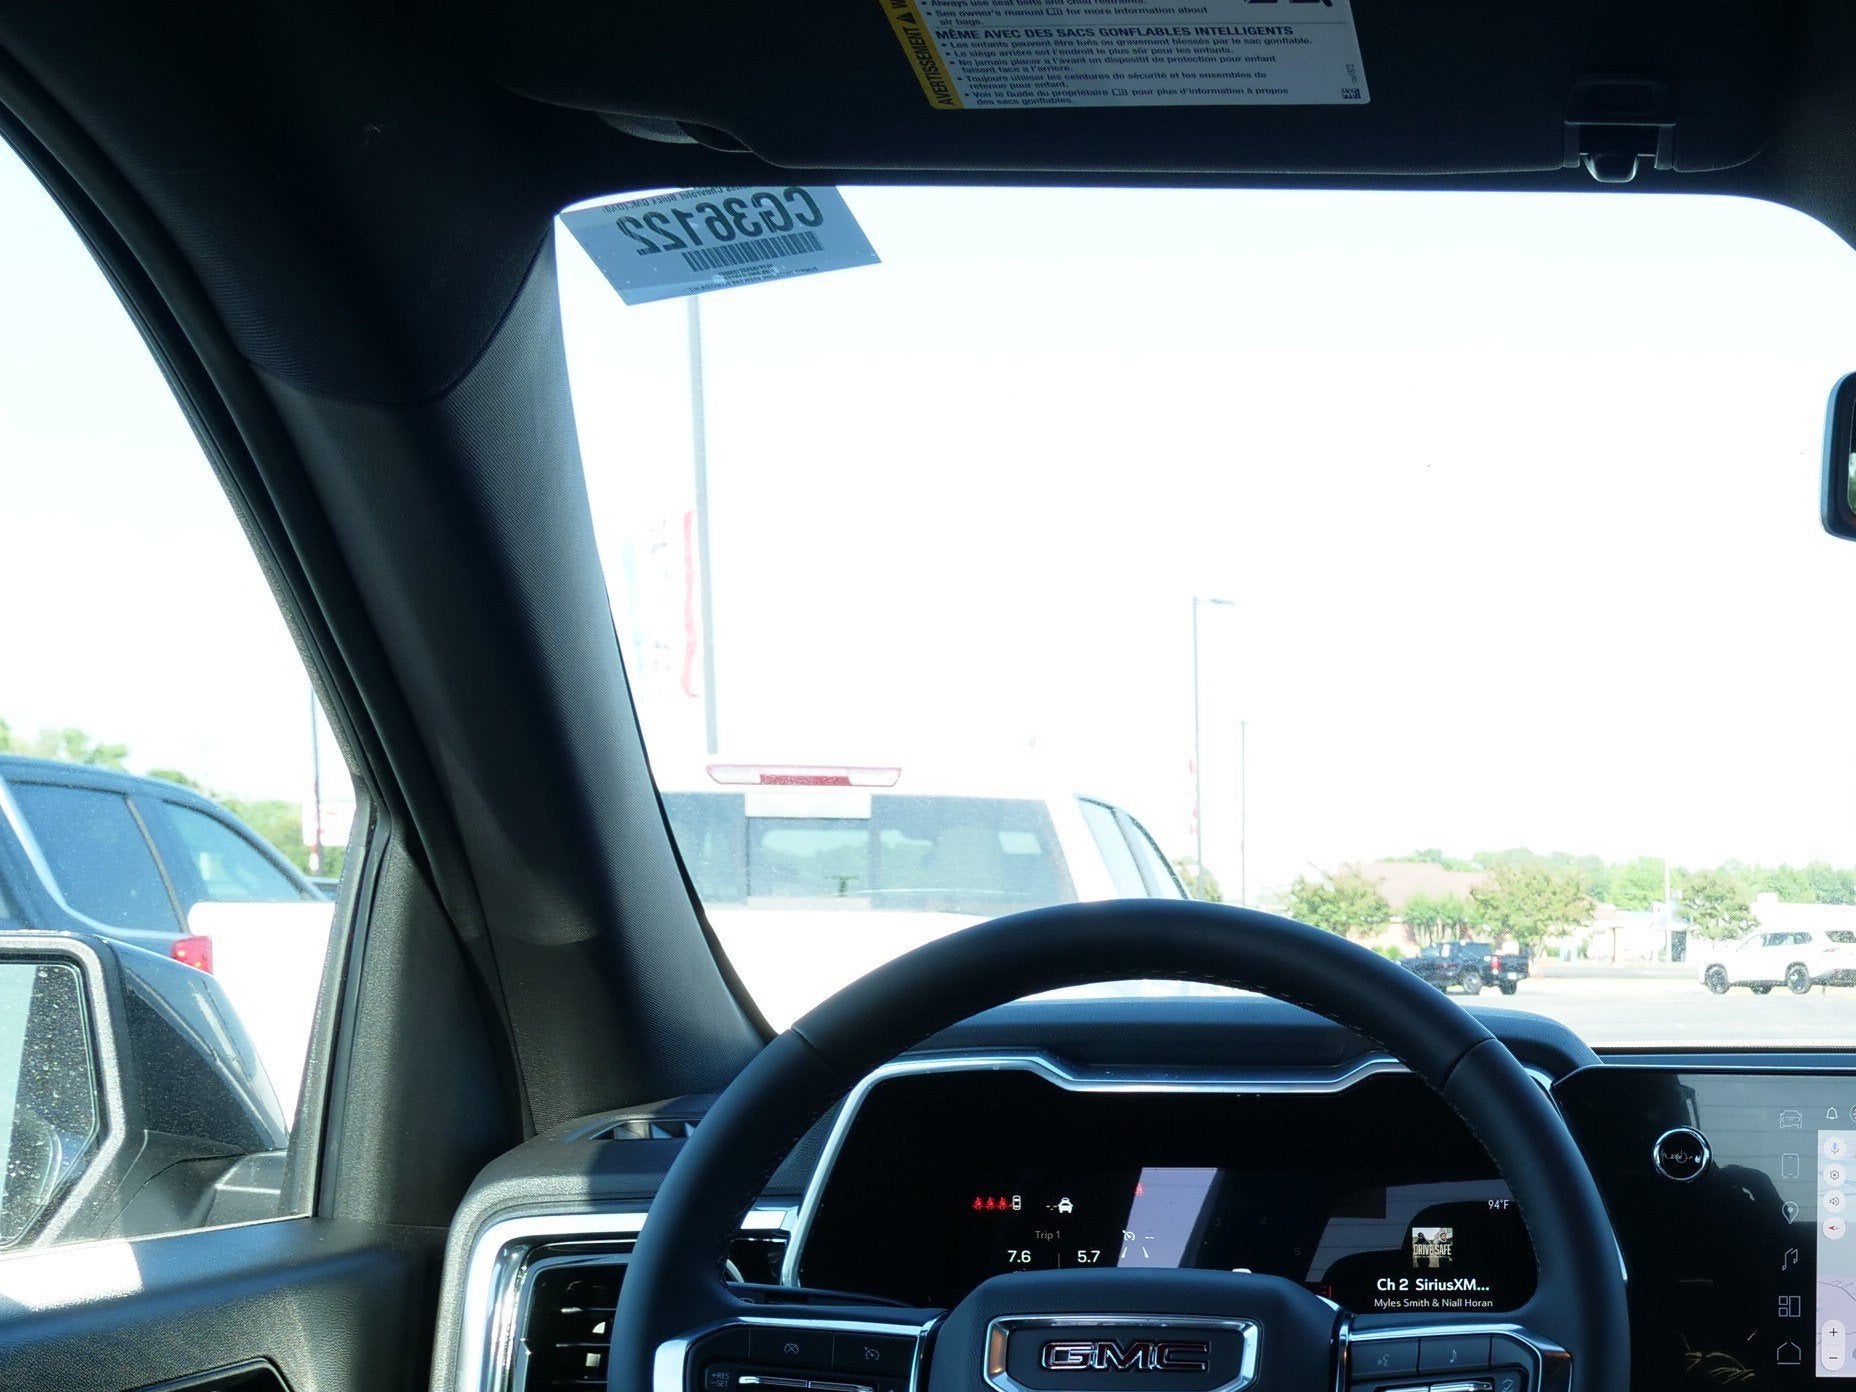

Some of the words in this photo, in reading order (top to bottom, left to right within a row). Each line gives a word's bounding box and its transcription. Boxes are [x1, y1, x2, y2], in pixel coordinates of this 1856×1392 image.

[936, 29, 979, 39] MÊME
[984, 30, 1020, 38] AVEC
[1025, 29, 1053, 38] DES
[1056, 28, 1095, 38] SACS
[1098, 27, 1192, 37] GONFLABLES
[1195, 26, 1293, 36] INTELLIGENTS
[1488, 1200, 1509, 1210] 94°F
[1034, 1230, 1054, 1242] Trip
[1056, 1231, 1060, 1239] 1
[1007, 1250, 1031, 1262] 7.6
[1077, 1250, 1100, 1262] 5.7
[1377, 1278, 1395, 1290] Ch
[1400, 1278, 1409, 1290] 2
[1415, 1278, 1490, 1290] SiriusXM...
[1374, 1298, 1402, 1309] Myles
[1404, 1298, 1430, 1307] Smith
[1432, 1298, 1440, 1307] &
[1442, 1298, 1462, 1307] Niall
[1464, 1298, 1493, 1307] Horan
[1041, 1340, 1210, 1373] GMC
